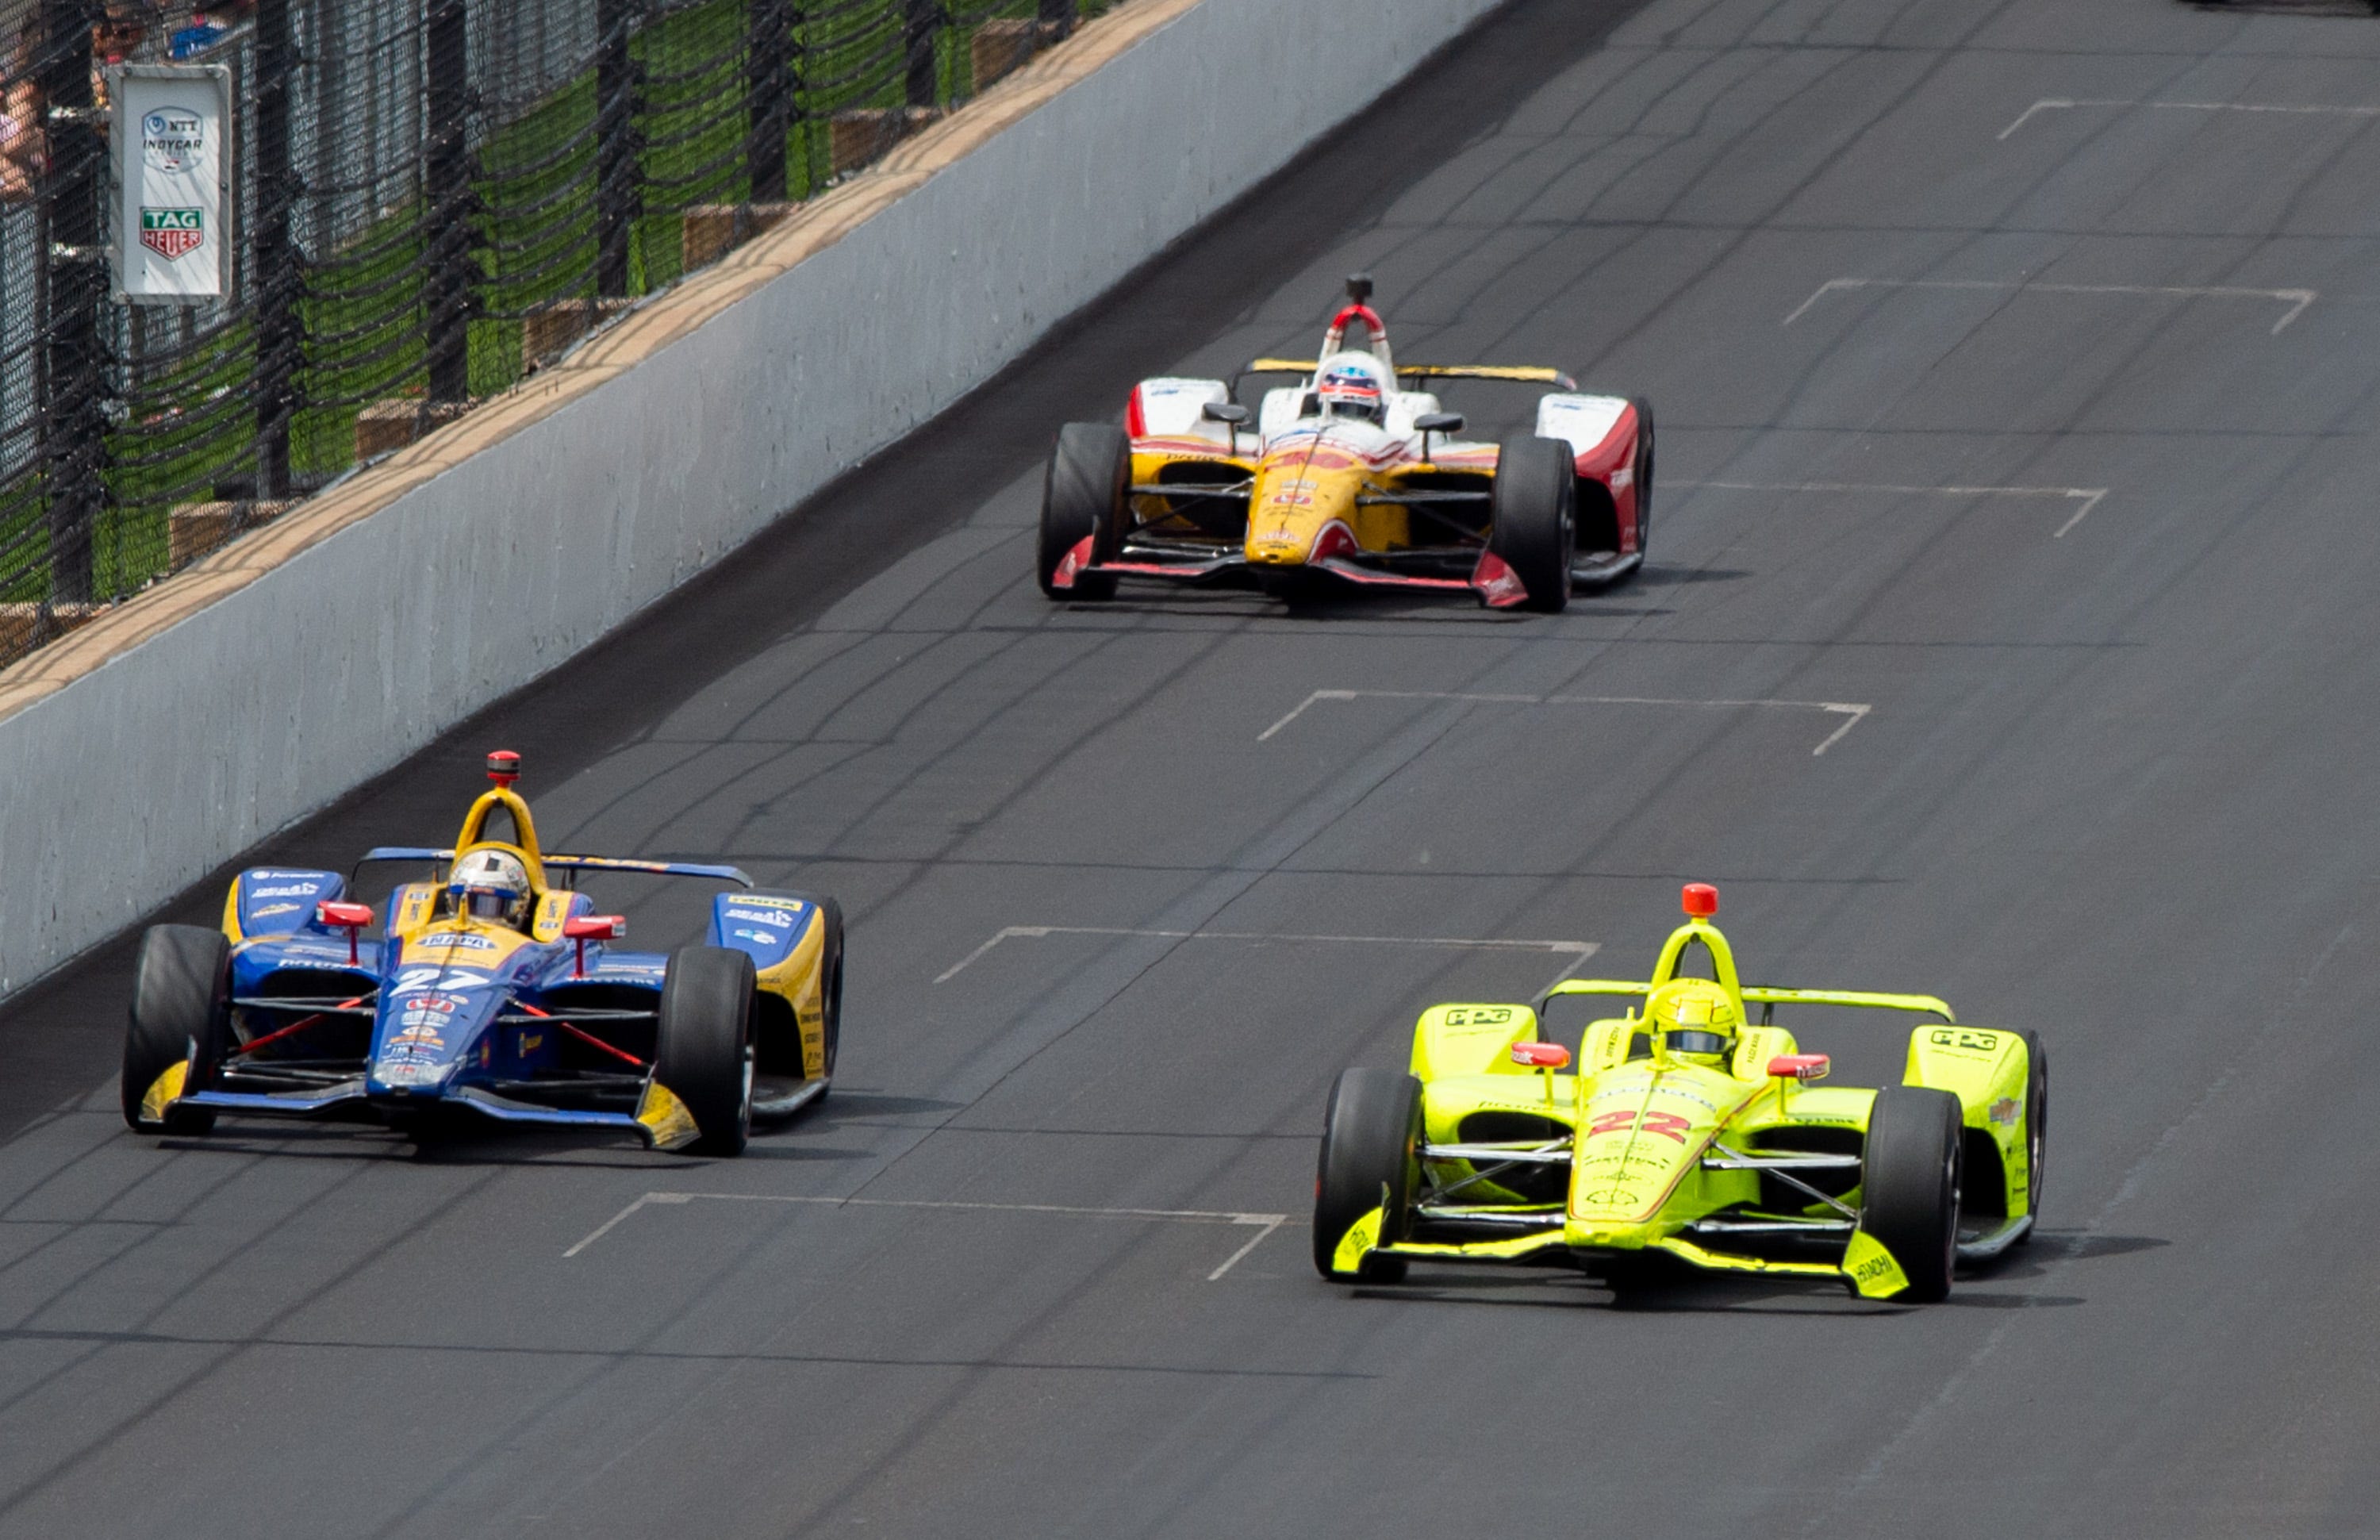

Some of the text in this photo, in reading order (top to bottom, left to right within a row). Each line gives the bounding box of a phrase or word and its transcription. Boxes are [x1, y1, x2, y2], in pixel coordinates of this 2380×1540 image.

[169, 120, 198, 132] NTT
[143, 139, 203, 151] INDYCAR
[145, 213, 198, 228] TAG
[144, 230, 200, 255] HEUER
[428, 935, 485, 948] NAPA
[388, 969, 490, 998] 27
[1445, 1008, 1512, 1026] PPG
[1931, 1030, 1998, 1051] PPG
[1587, 1110, 1691, 1146] 22
